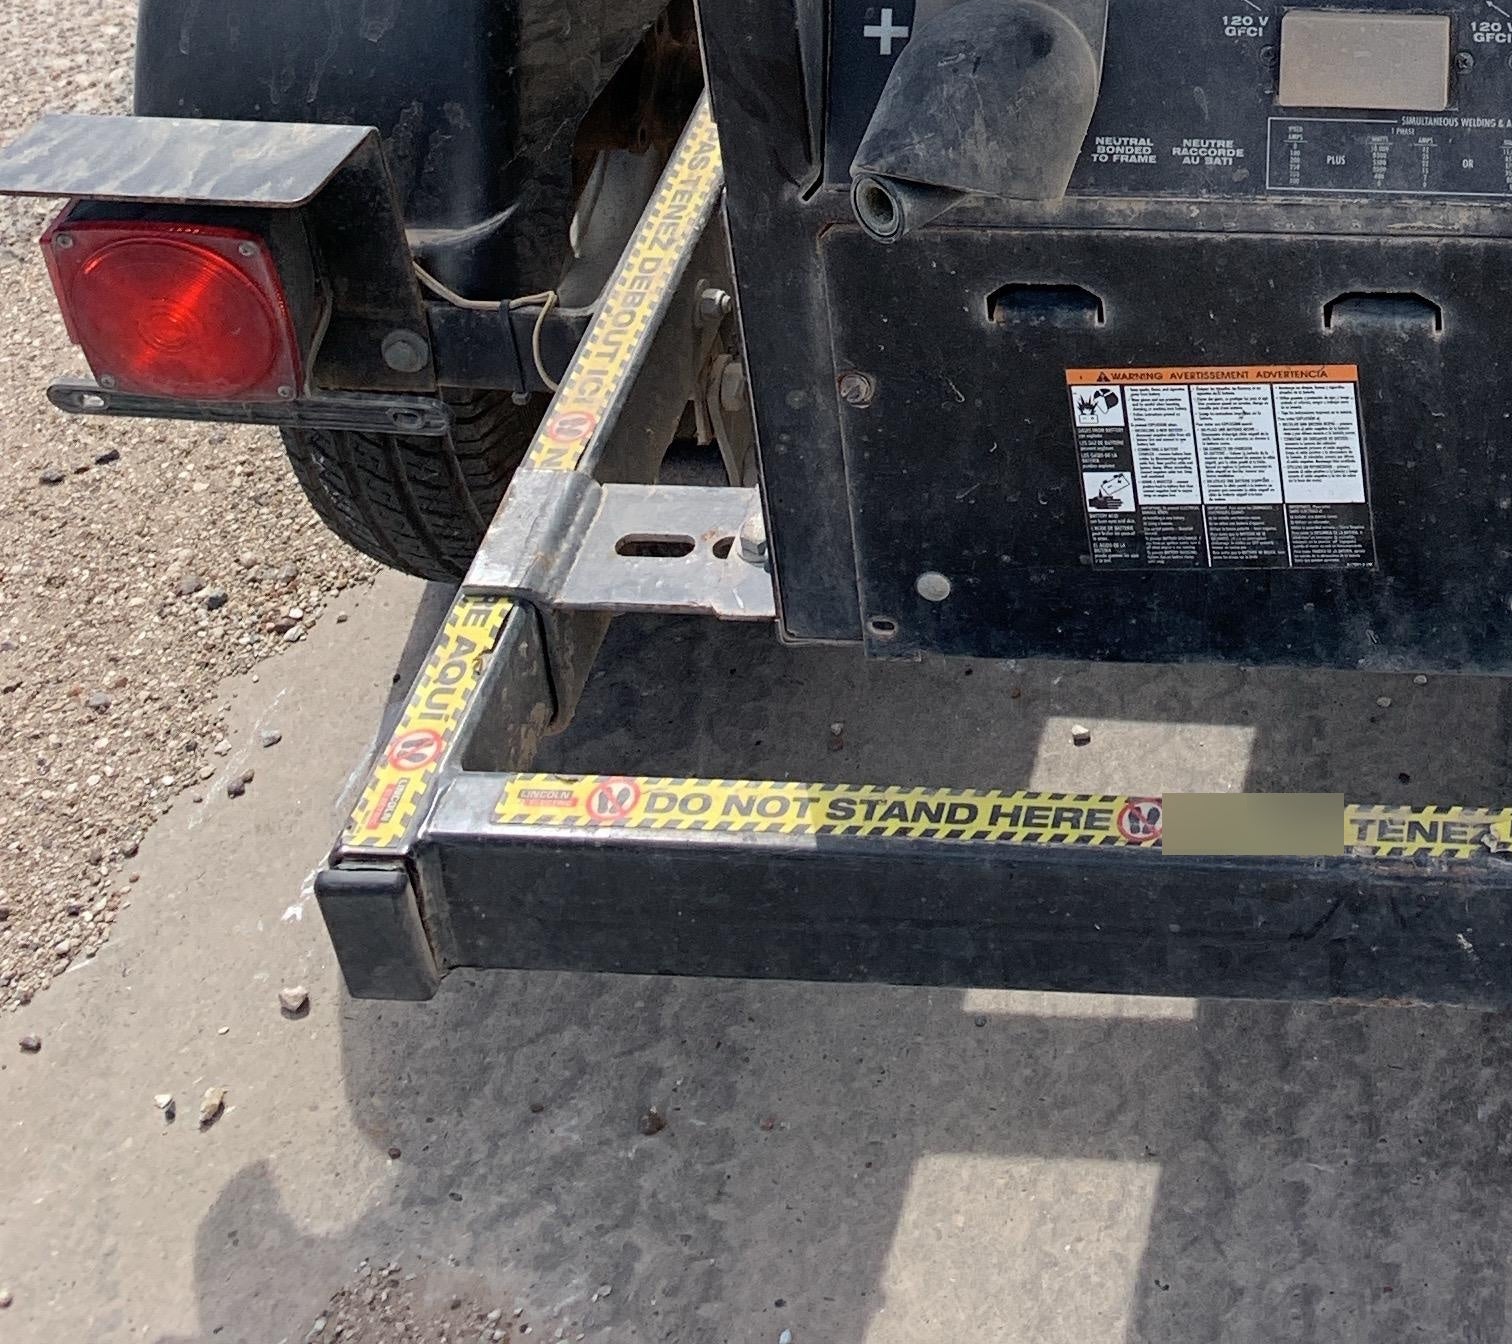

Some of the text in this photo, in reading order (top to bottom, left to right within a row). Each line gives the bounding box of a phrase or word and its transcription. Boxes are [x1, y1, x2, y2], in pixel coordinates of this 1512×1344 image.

[1222, 16, 1269, 26] 120 V
[1225, 26, 1263, 37] GFCI
[1471, 22, 1505, 32] 120
[1473, 32, 1512, 43] GFCI
[1402, 116, 1459, 127] SIMULTANEOUS
[1461, 117, 1496, 128] WELDING
[1095, 137, 1154, 146] NEUTRAL
[1183, 139, 1234, 148] NEUTRE
[1097, 145, 1152, 154] BONDED
[1172, 147, 1245, 158] RACCORDE
[1091, 154, 1157, 164] TO FRAME
[1182, 157, 1233, 166] AU BATI
[1327, 155, 1346, 165] PLUS
[1462, 159, 1474, 169] OR
[647, 175, 704, 251] TENEZ
[595, 256, 664, 363] DEBOUT
[1111, 369, 1328, 380] WARNING AVERTISSEMENT ADVERTENCIA
[572, 368, 611, 406] ICI
[541, 447, 563, 469] N
[519, 790, 571, 800] LINCOLN
[643, 792, 1113, 832] DO NOT STAND HERE
[1350, 819, 1492, 845] TENEZ
